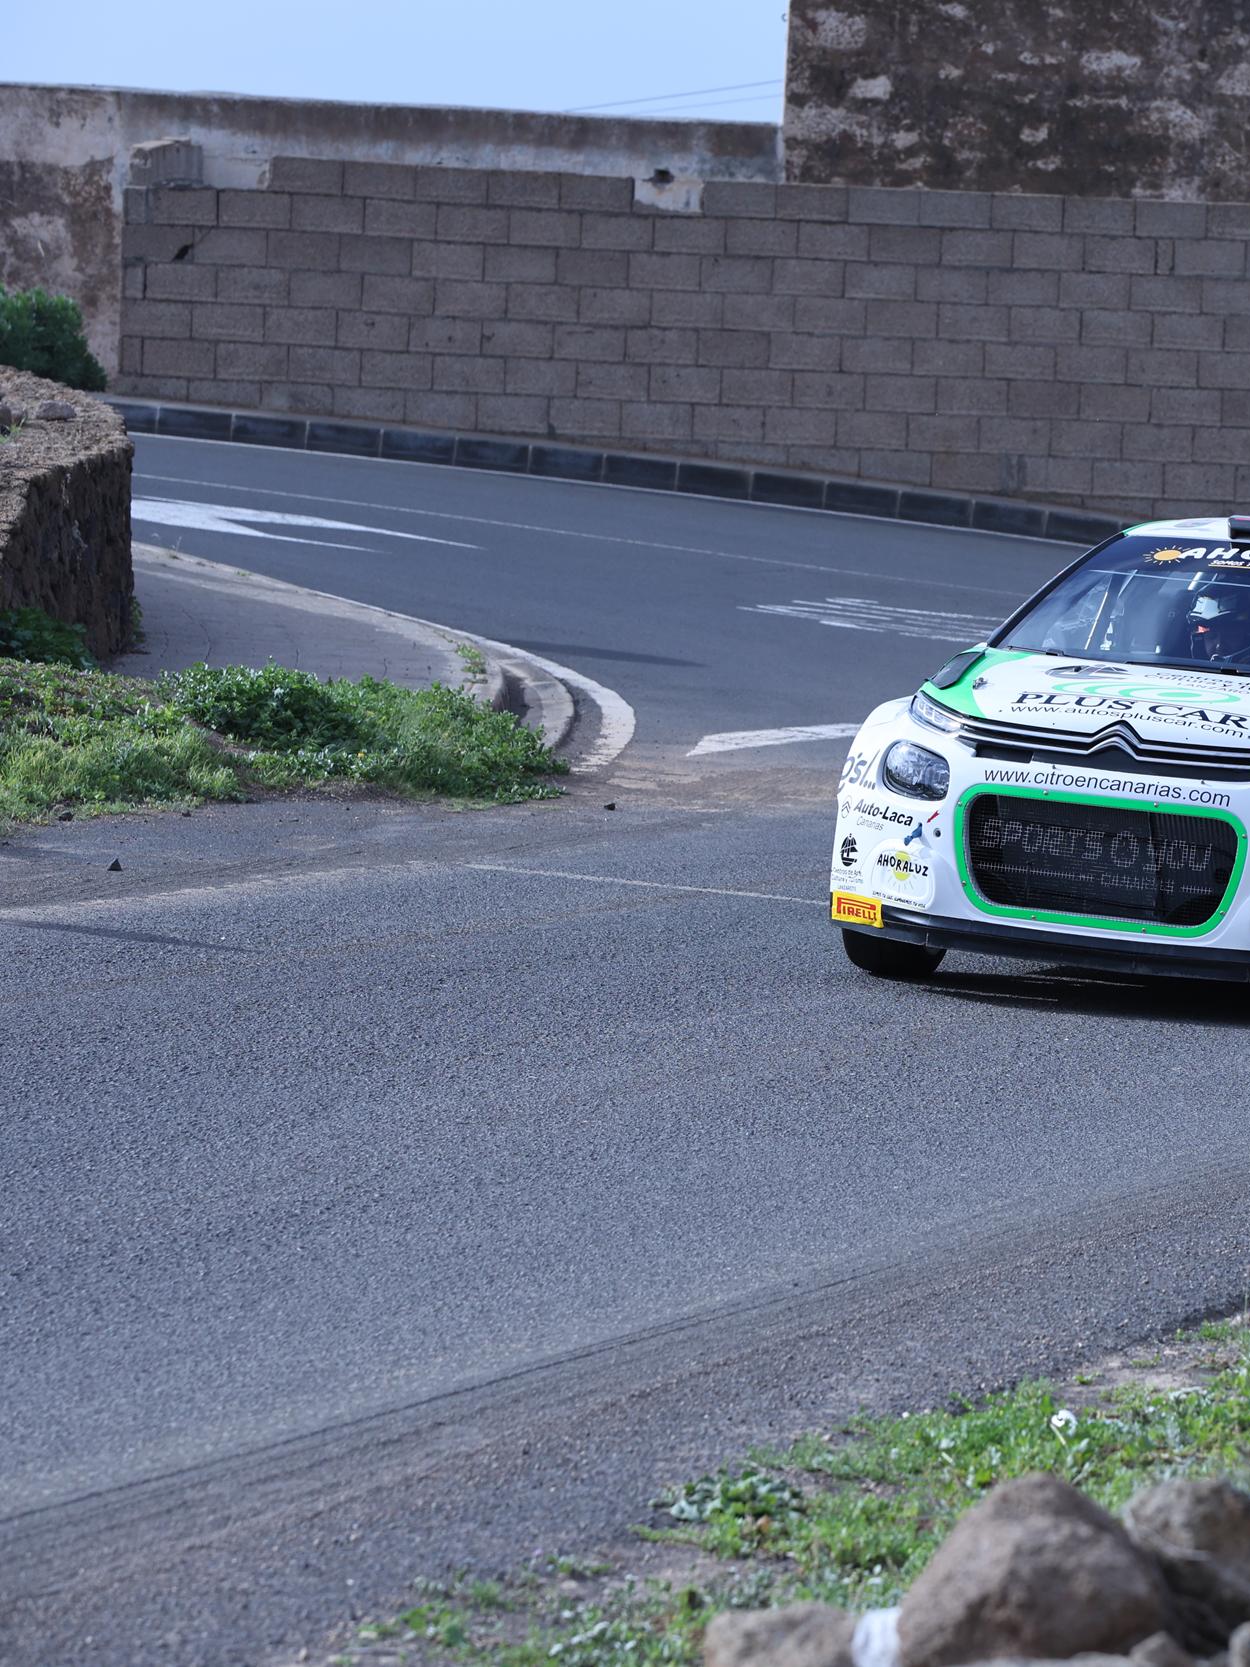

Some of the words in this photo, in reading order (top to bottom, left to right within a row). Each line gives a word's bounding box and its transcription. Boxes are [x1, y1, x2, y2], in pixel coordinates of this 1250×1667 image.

[1010, 703, 1244, 739] www.autospluscar.com
[1014, 693, 1138, 711] PLUS
[1149, 703, 1250, 730] CAR
[984, 768, 1231, 808] www.citroencanarias.com
[854, 798, 914, 827] Auto-Laca
[876, 853, 929, 878] AHORALUZ
[837, 896, 877, 922] PIRELLI
